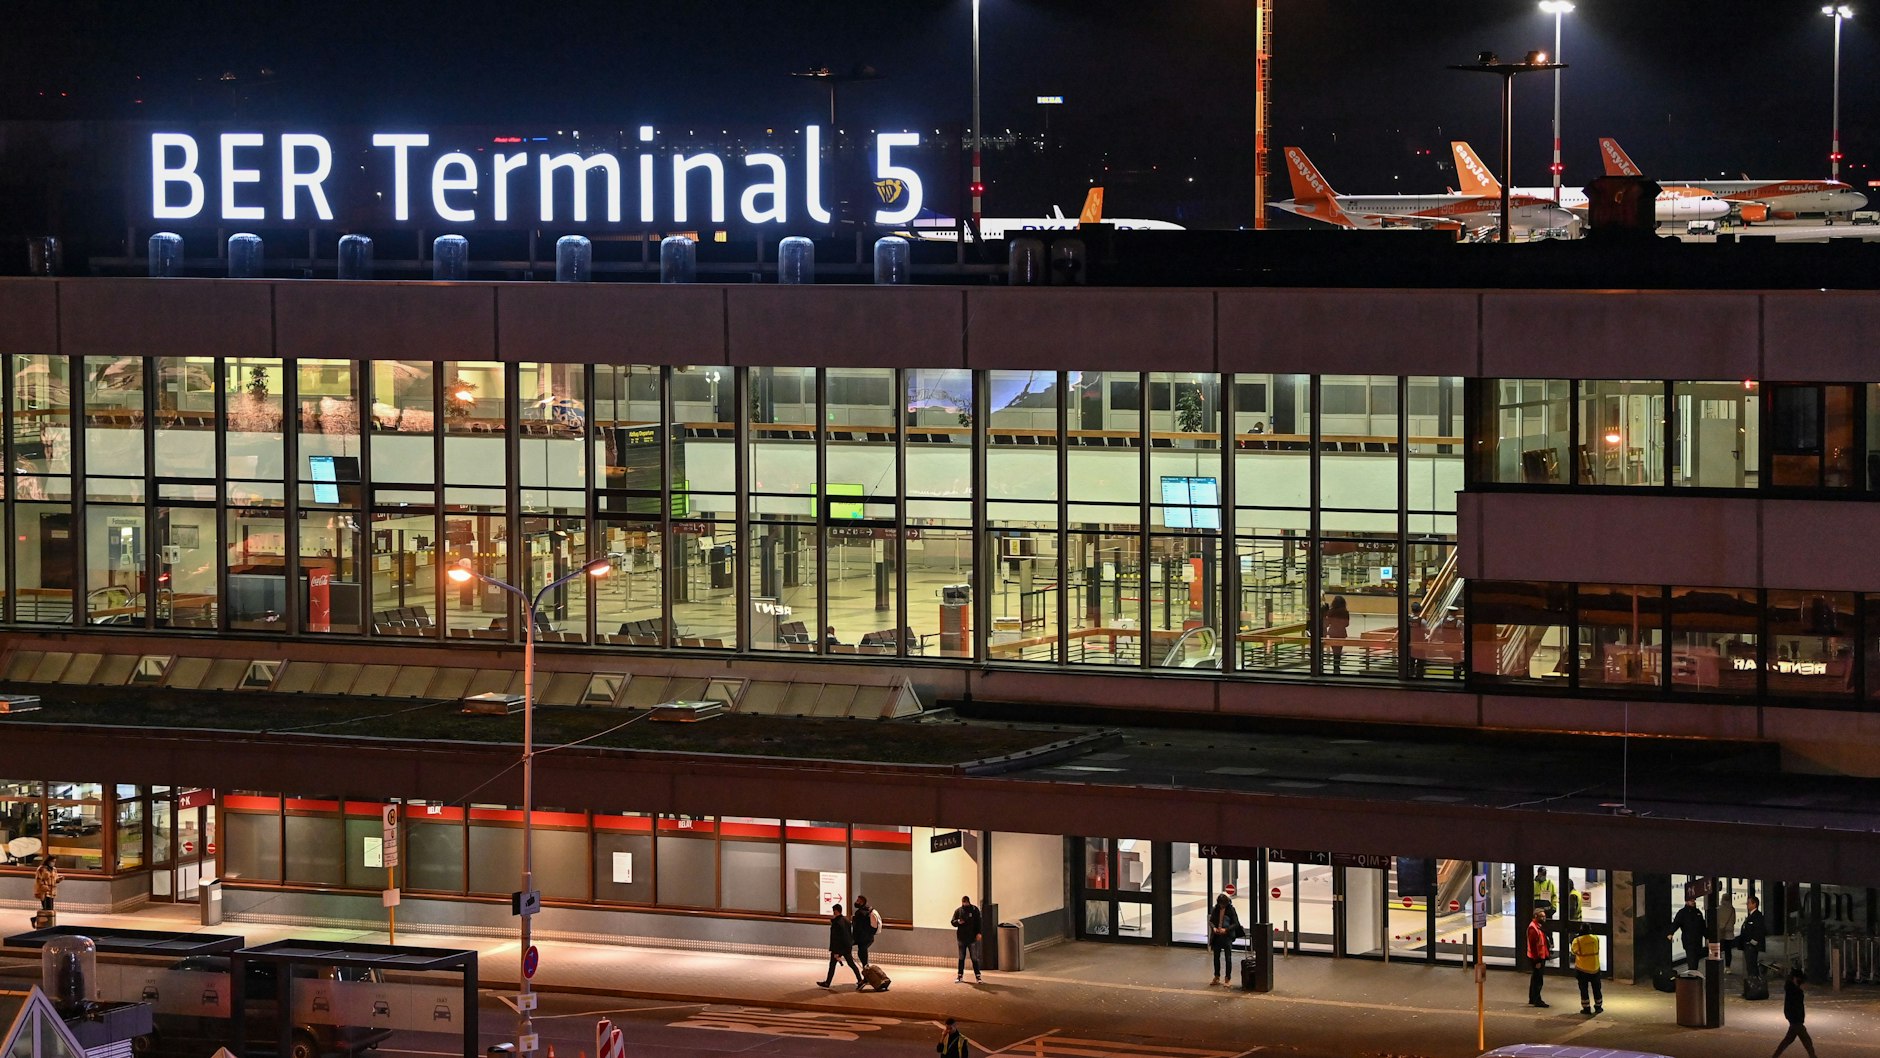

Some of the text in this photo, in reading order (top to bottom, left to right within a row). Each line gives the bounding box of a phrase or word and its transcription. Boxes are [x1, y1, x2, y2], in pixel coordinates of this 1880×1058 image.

[1455, 144, 1490, 187] easyJet
[152, 125, 923, 224] BER Terminal 5
[1288, 150, 1324, 193] easyJet
[1778, 184, 1820, 193] easyJet
[185, 795, 191, 806] K
[678, 819, 693, 830] RELAY
[1210, 845, 1218, 856] K
[1280, 849, 1286, 860] L
